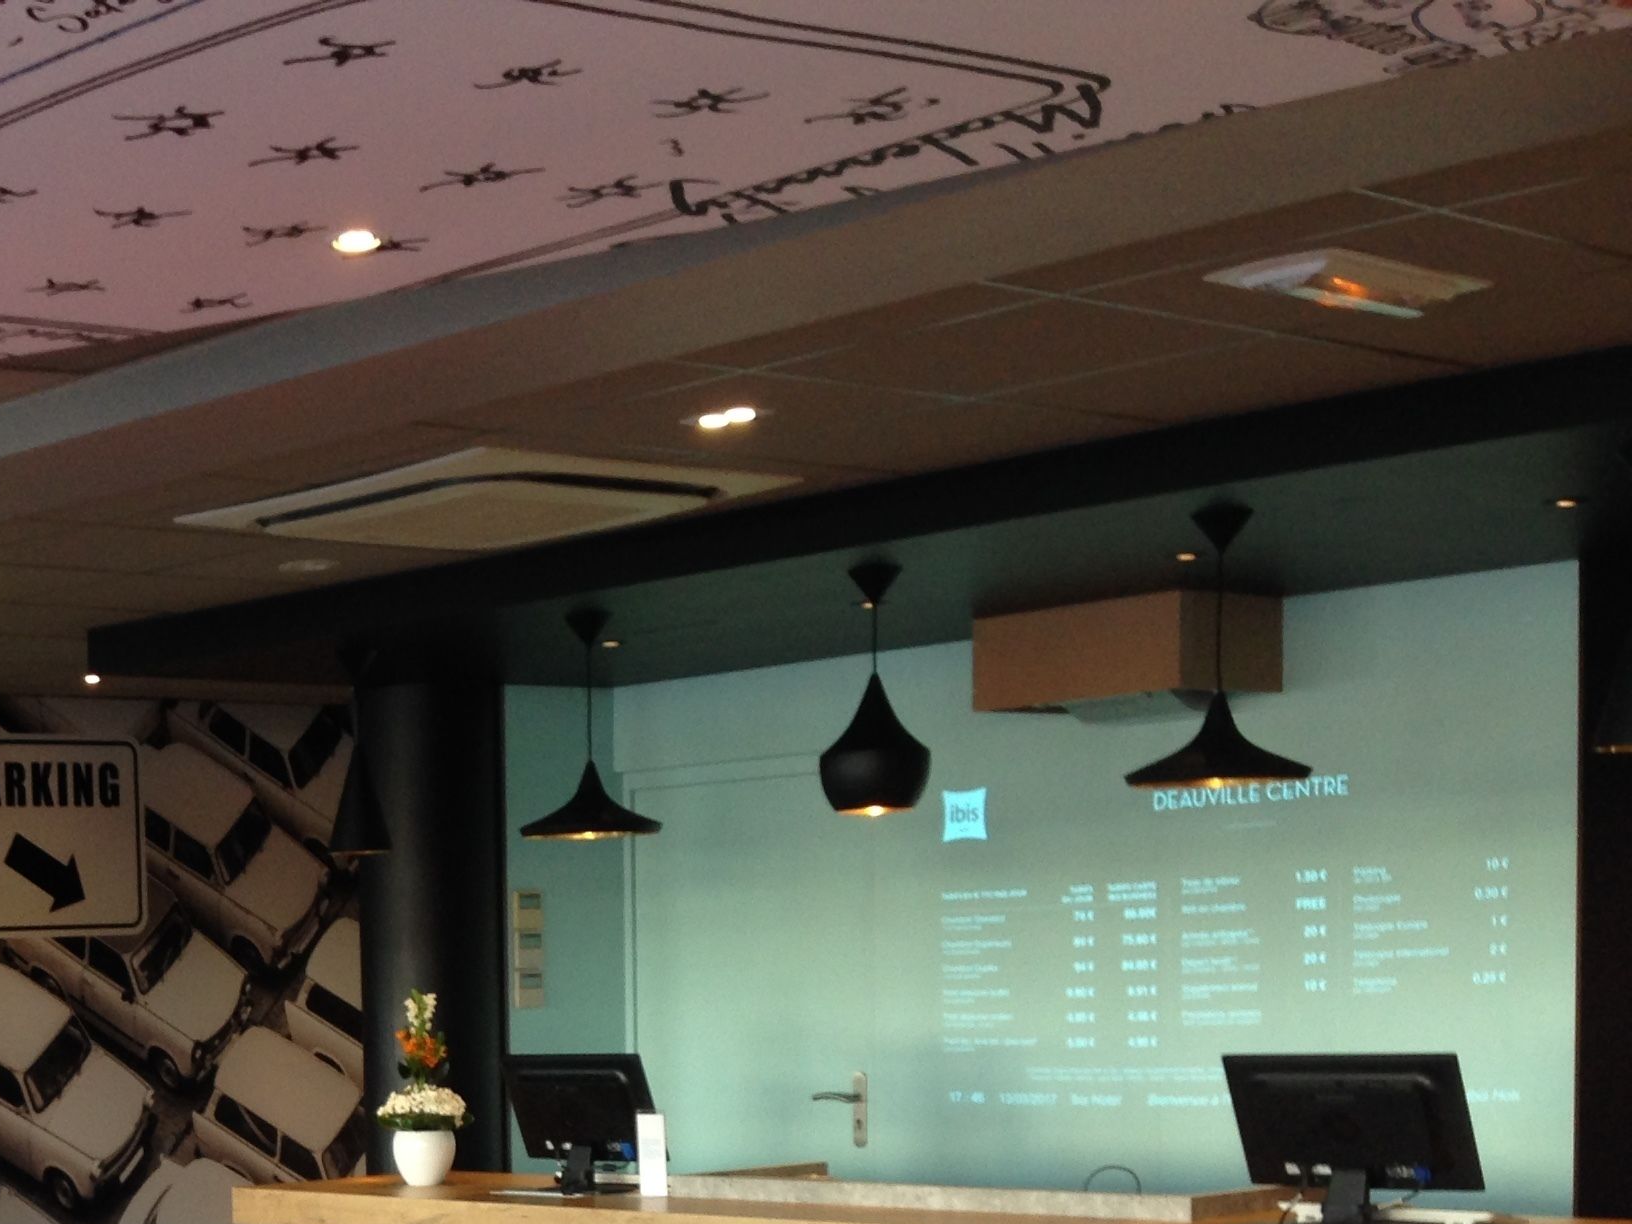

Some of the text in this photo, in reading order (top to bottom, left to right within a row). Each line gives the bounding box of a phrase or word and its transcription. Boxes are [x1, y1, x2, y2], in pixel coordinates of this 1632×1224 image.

[1152, 773, 1350, 812] DEAUVILLE CENTRE
[948, 803, 980, 824] ibis
[1296, 896, 1327, 910] FREE
